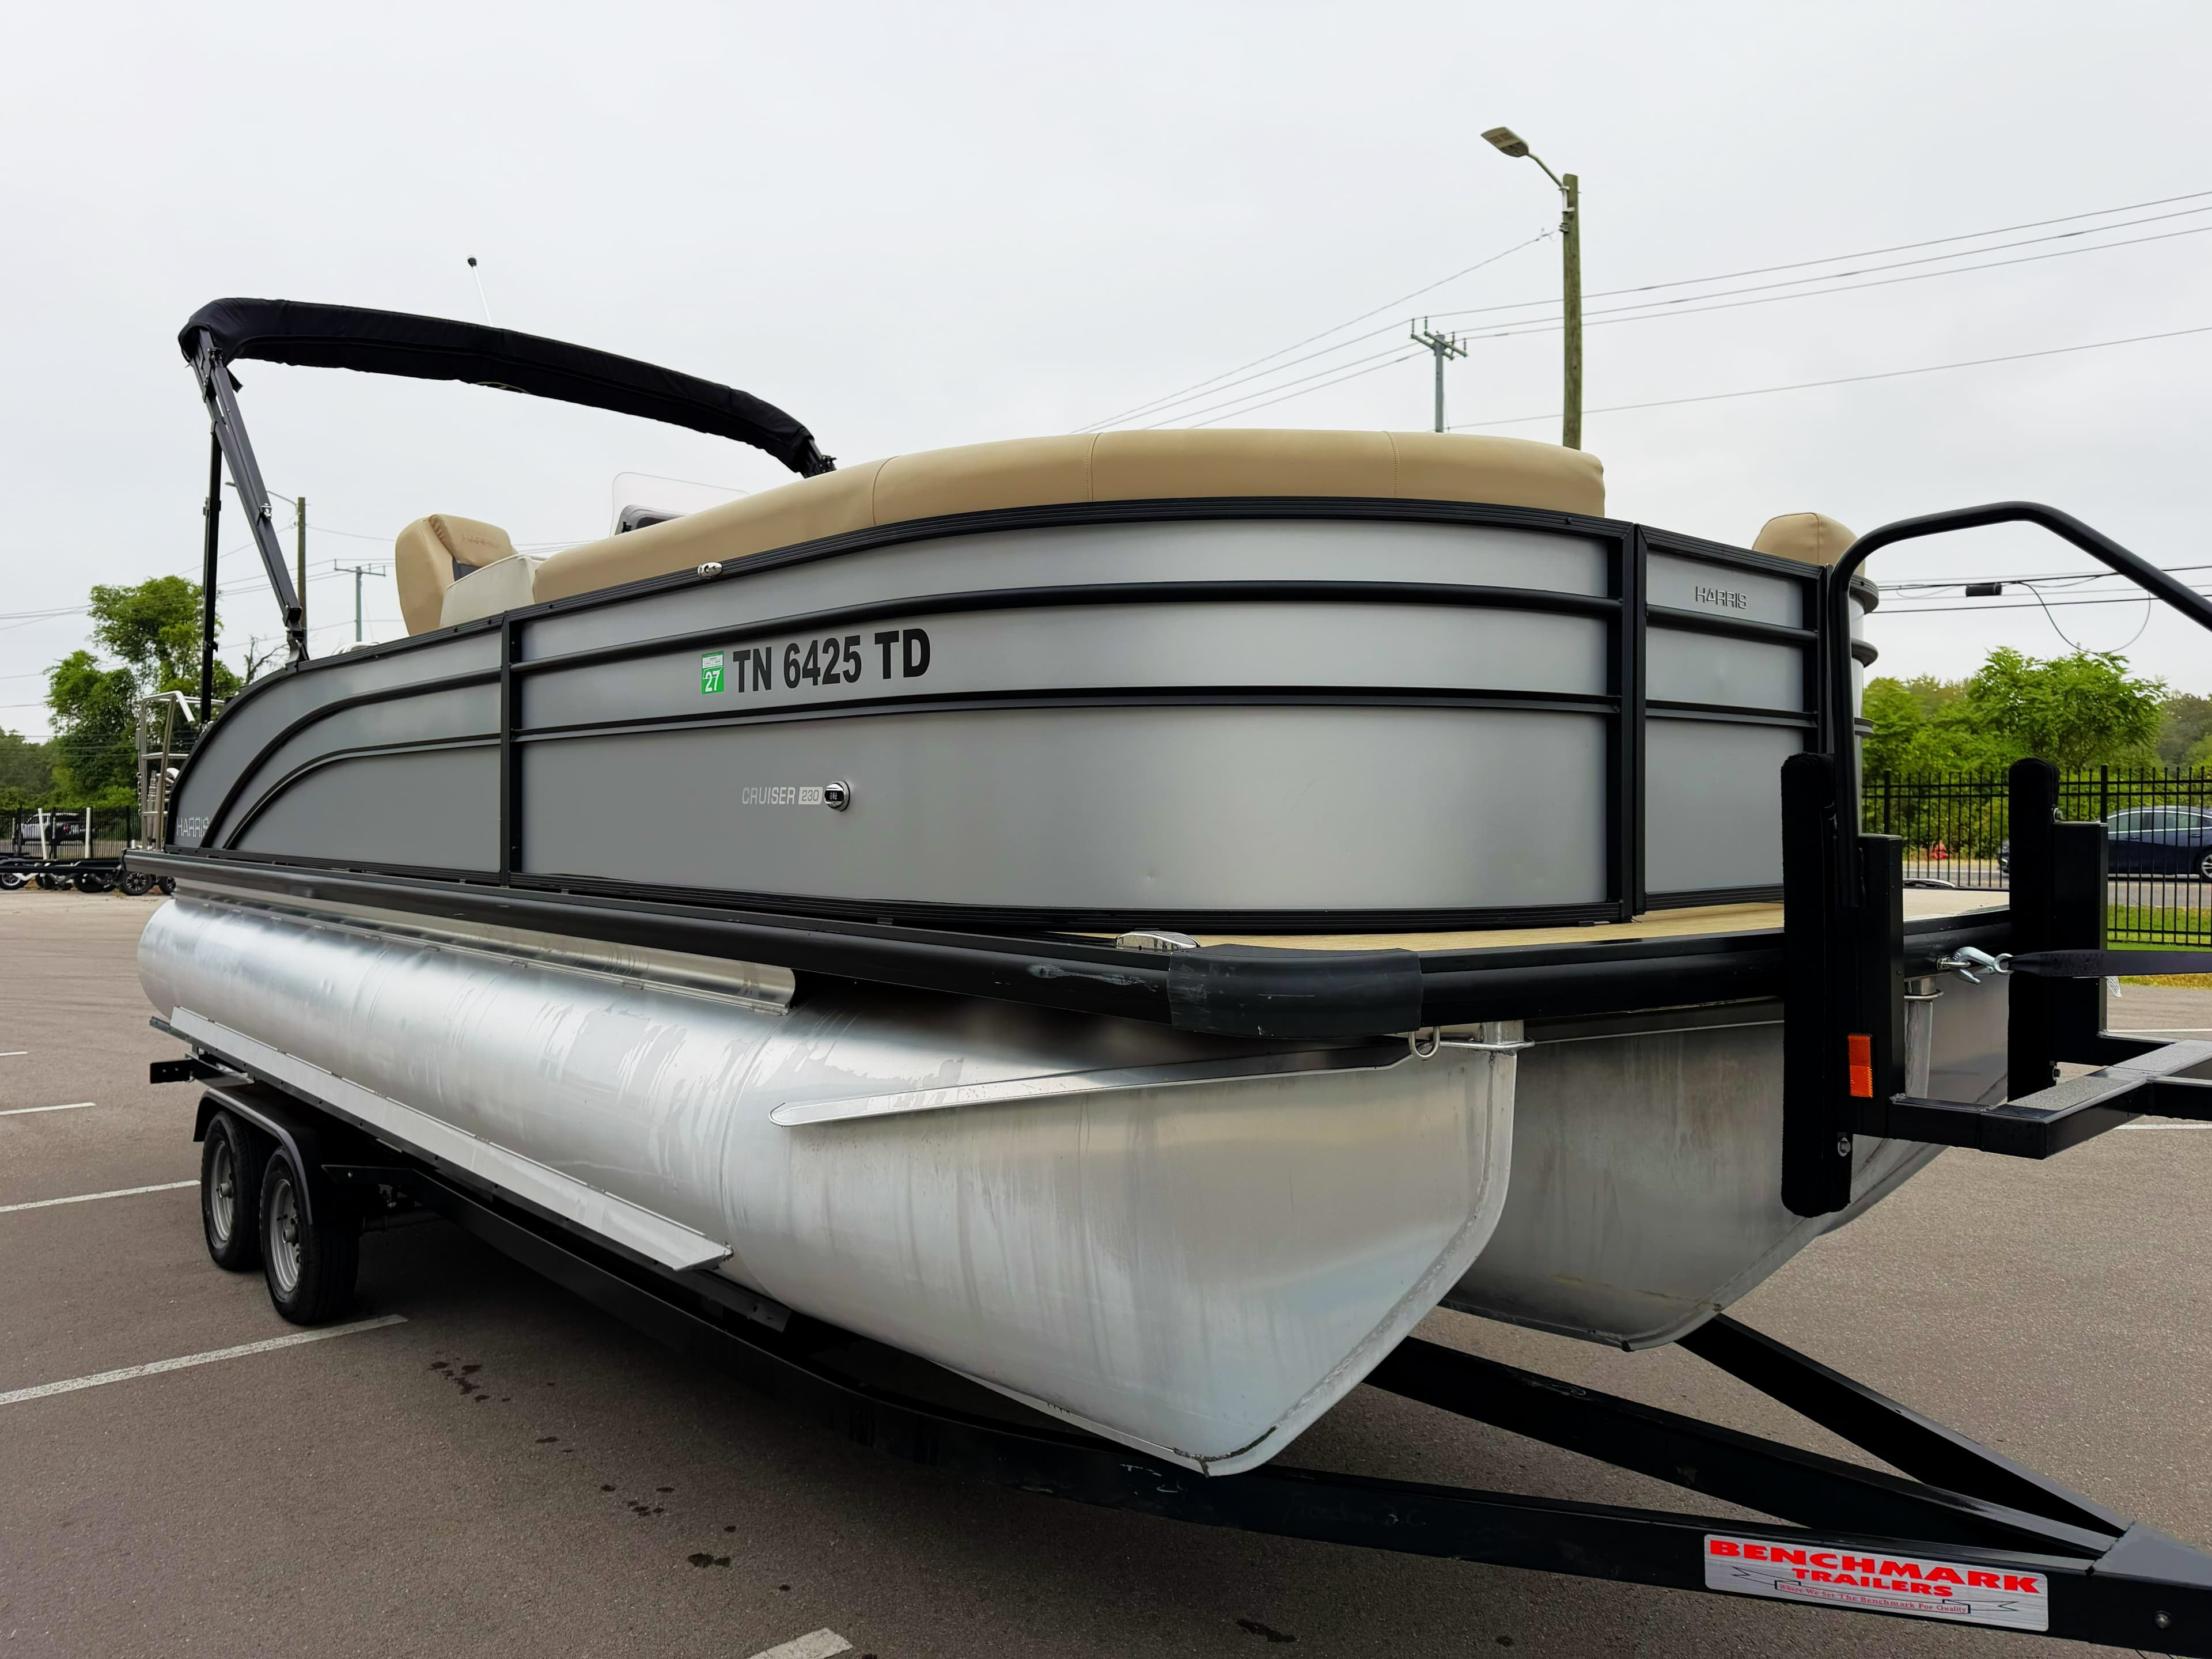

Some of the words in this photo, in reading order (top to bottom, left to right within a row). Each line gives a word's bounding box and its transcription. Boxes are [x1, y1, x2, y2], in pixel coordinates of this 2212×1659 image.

[1695, 586, 1747, 609] HARRIS
[733, 646, 772, 693] TN
[783, 635, 862, 690] 6425
[874, 628, 931, 680] TD
[705, 671, 720, 692] 27
[742, 786, 796, 805] CRUISER
[801, 789, 820, 802] 230
[1710, 1540, 2040, 1594] BENCHMARK
[1791, 1568, 1953, 1597] TRAILERS
[1779, 1584, 1803, 1593] Where
[1861, 1596, 1915, 1609] Benchmark
[1936, 1605, 1967, 1613] Quality
